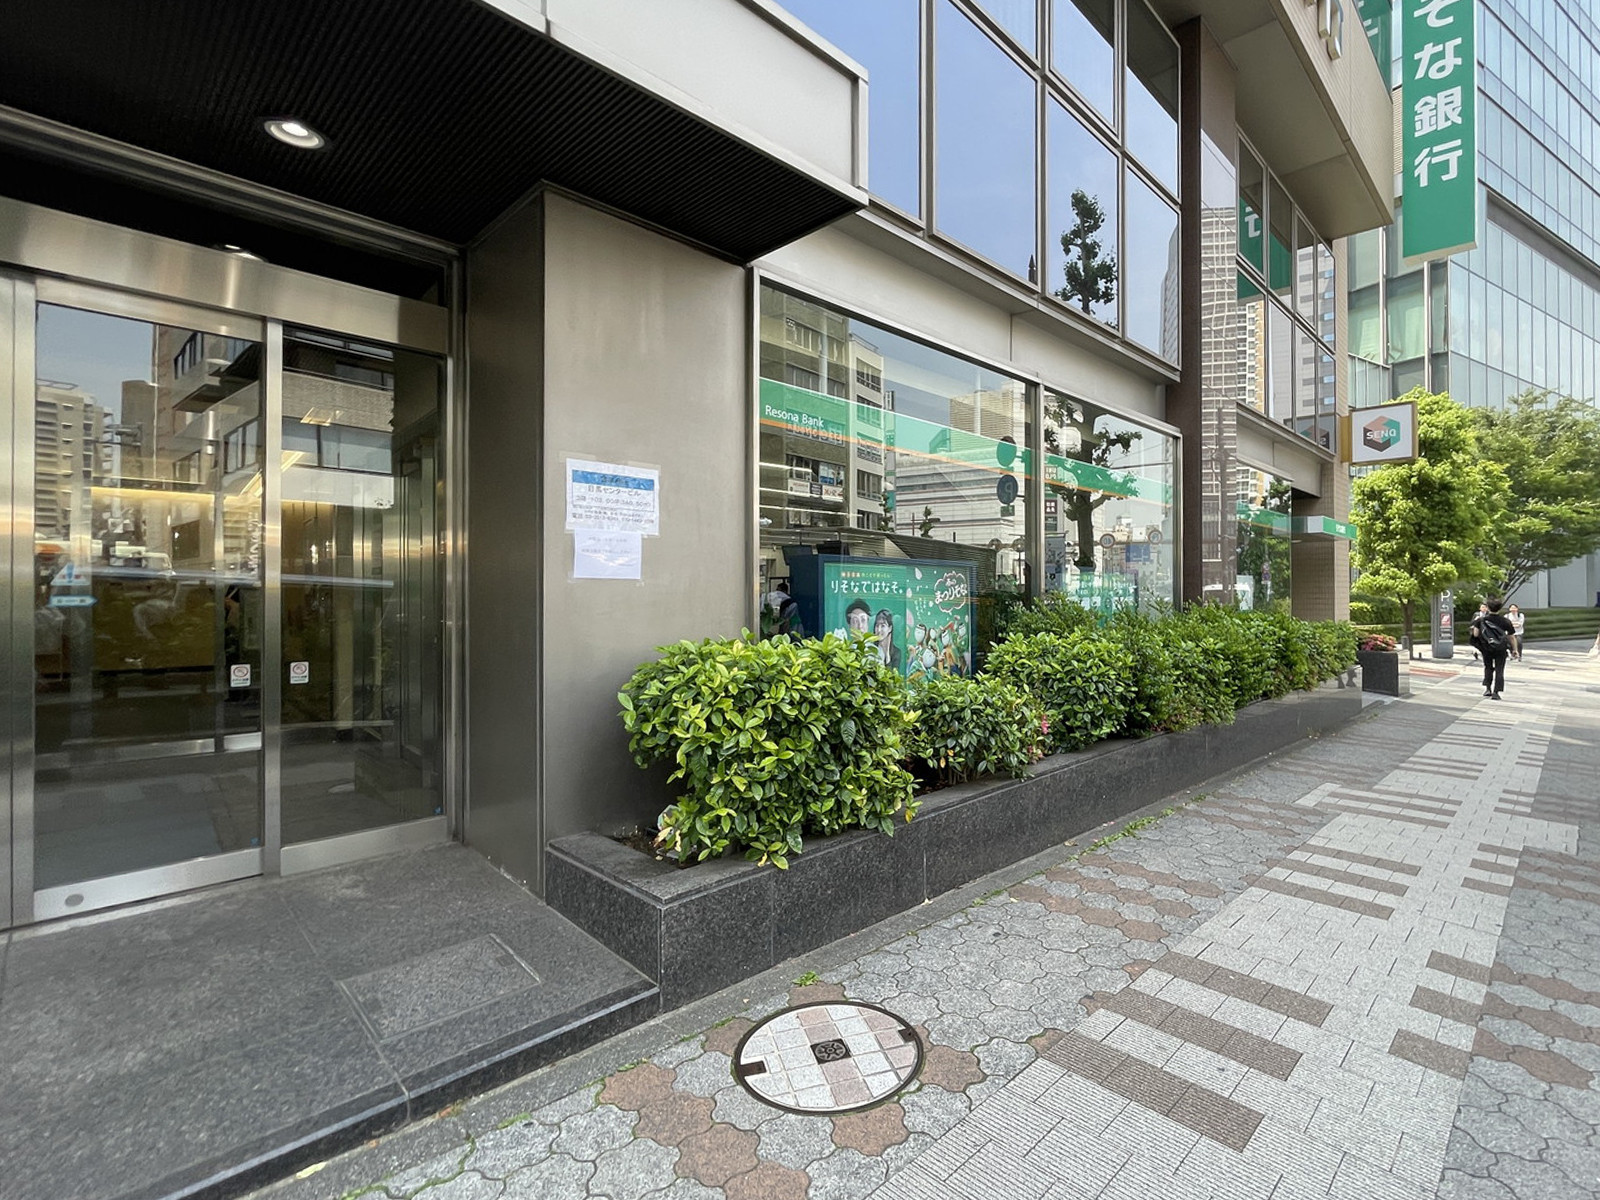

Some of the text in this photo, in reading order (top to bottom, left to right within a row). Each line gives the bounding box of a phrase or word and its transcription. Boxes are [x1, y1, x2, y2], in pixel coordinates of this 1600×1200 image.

[765, 404, 824, 428] Resona Bank
[1441, 590, 1451, 602] P
